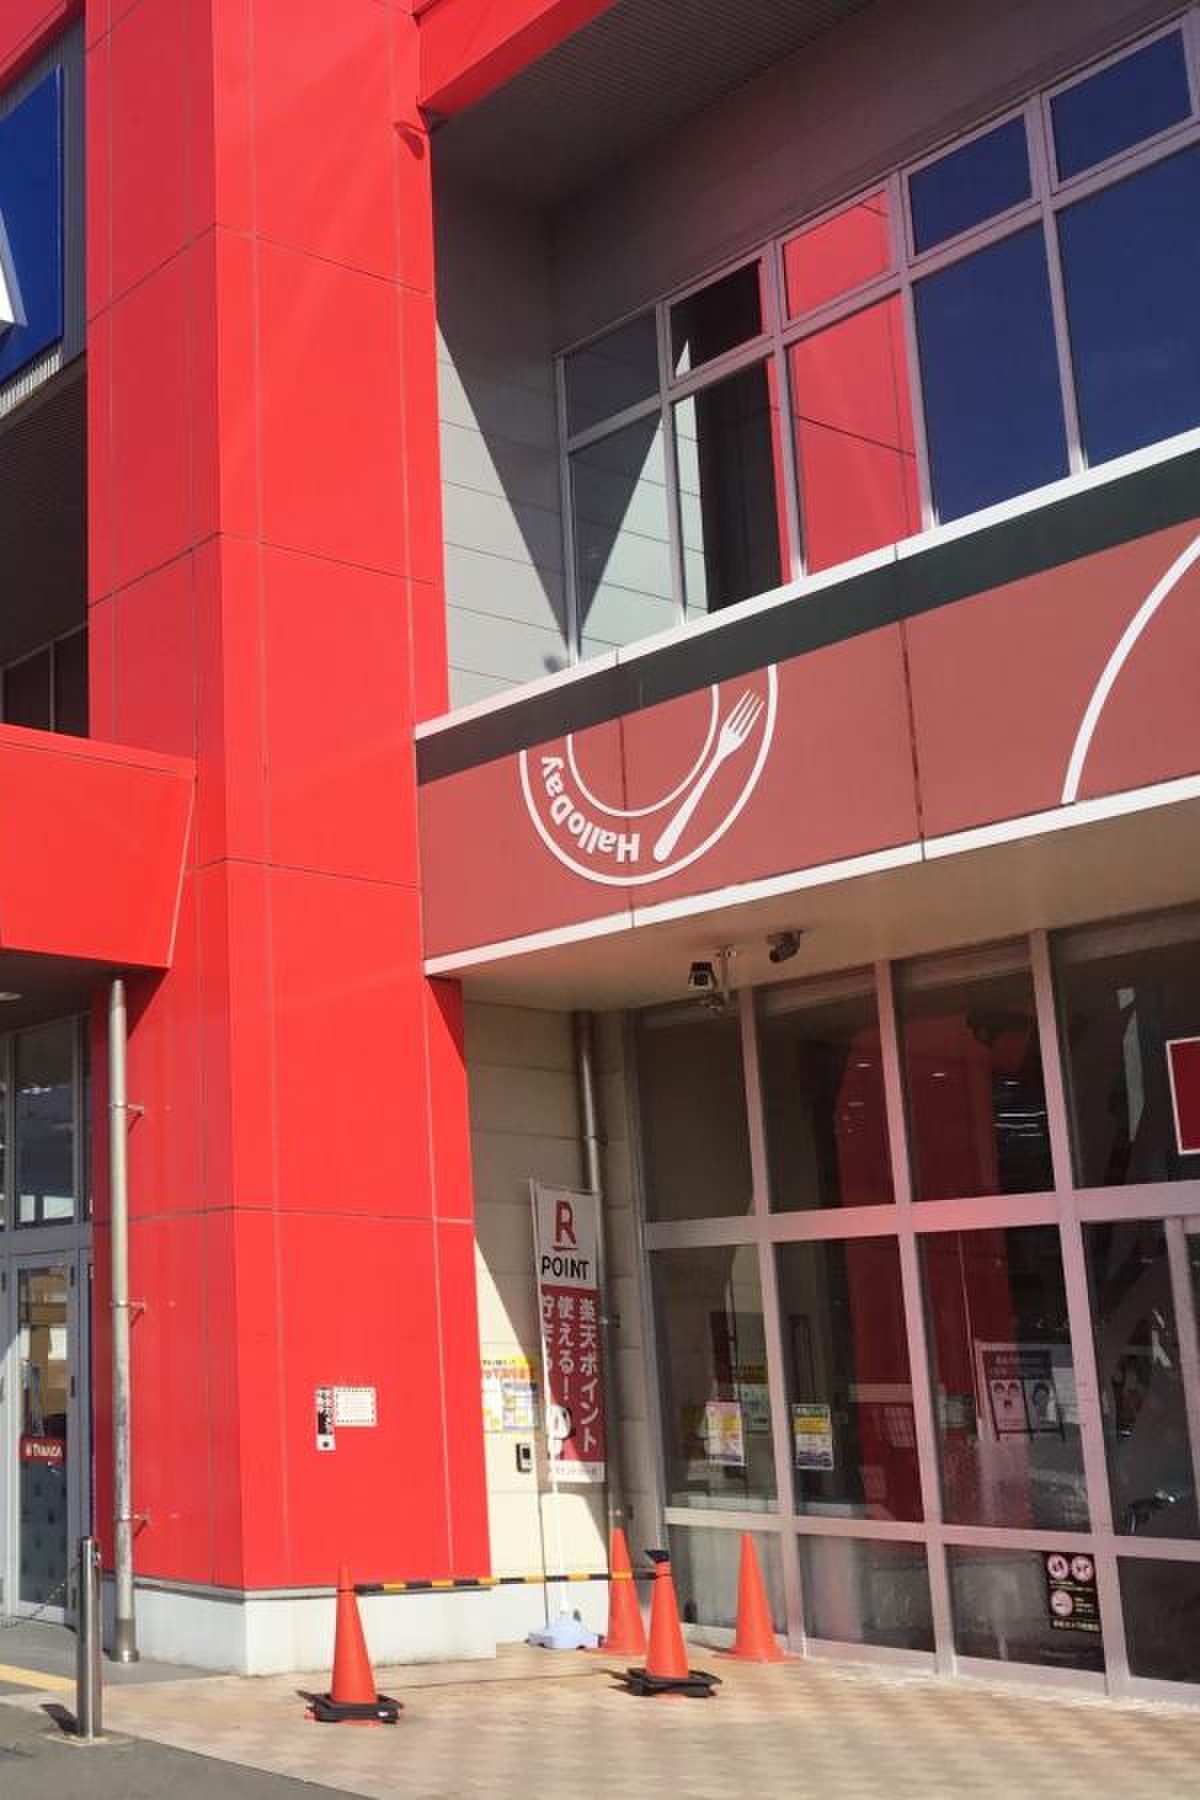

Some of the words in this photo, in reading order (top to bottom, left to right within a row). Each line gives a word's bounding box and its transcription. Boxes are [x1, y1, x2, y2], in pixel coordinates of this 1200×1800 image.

[541, 756, 640, 863] HalloDay
[555, 1200, 577, 1245] R
[541, 1254, 590, 1280] POINT
